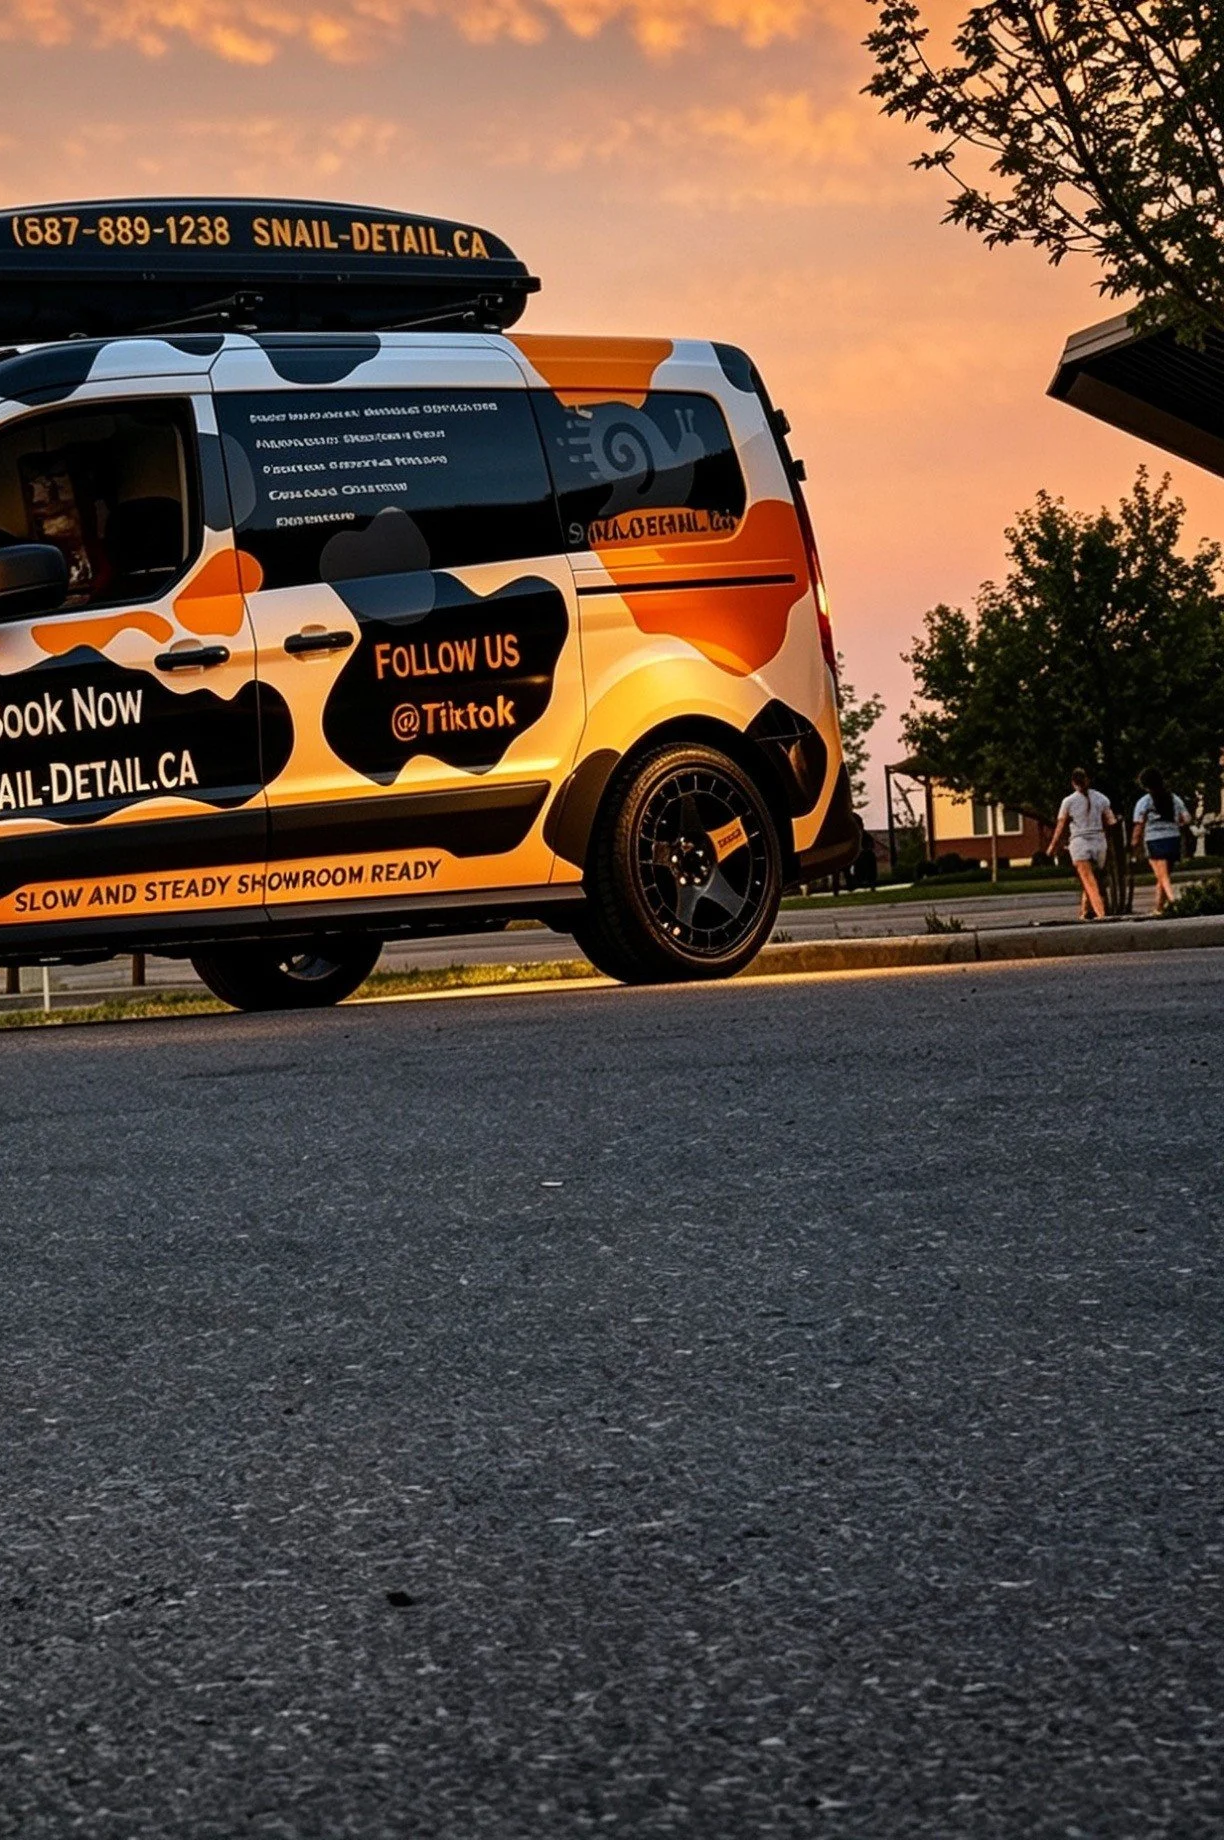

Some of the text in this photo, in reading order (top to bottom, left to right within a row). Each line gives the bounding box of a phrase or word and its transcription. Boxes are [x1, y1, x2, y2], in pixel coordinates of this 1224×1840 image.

[252, 217, 490, 259] SNAIL-DETAIL.CA
[375, 634, 520, 680] FOLLOW US
[391, 695, 517, 741] @Tiktok
[15, 858, 442, 912] SLOW AND STEADY SHOWROOM READY
